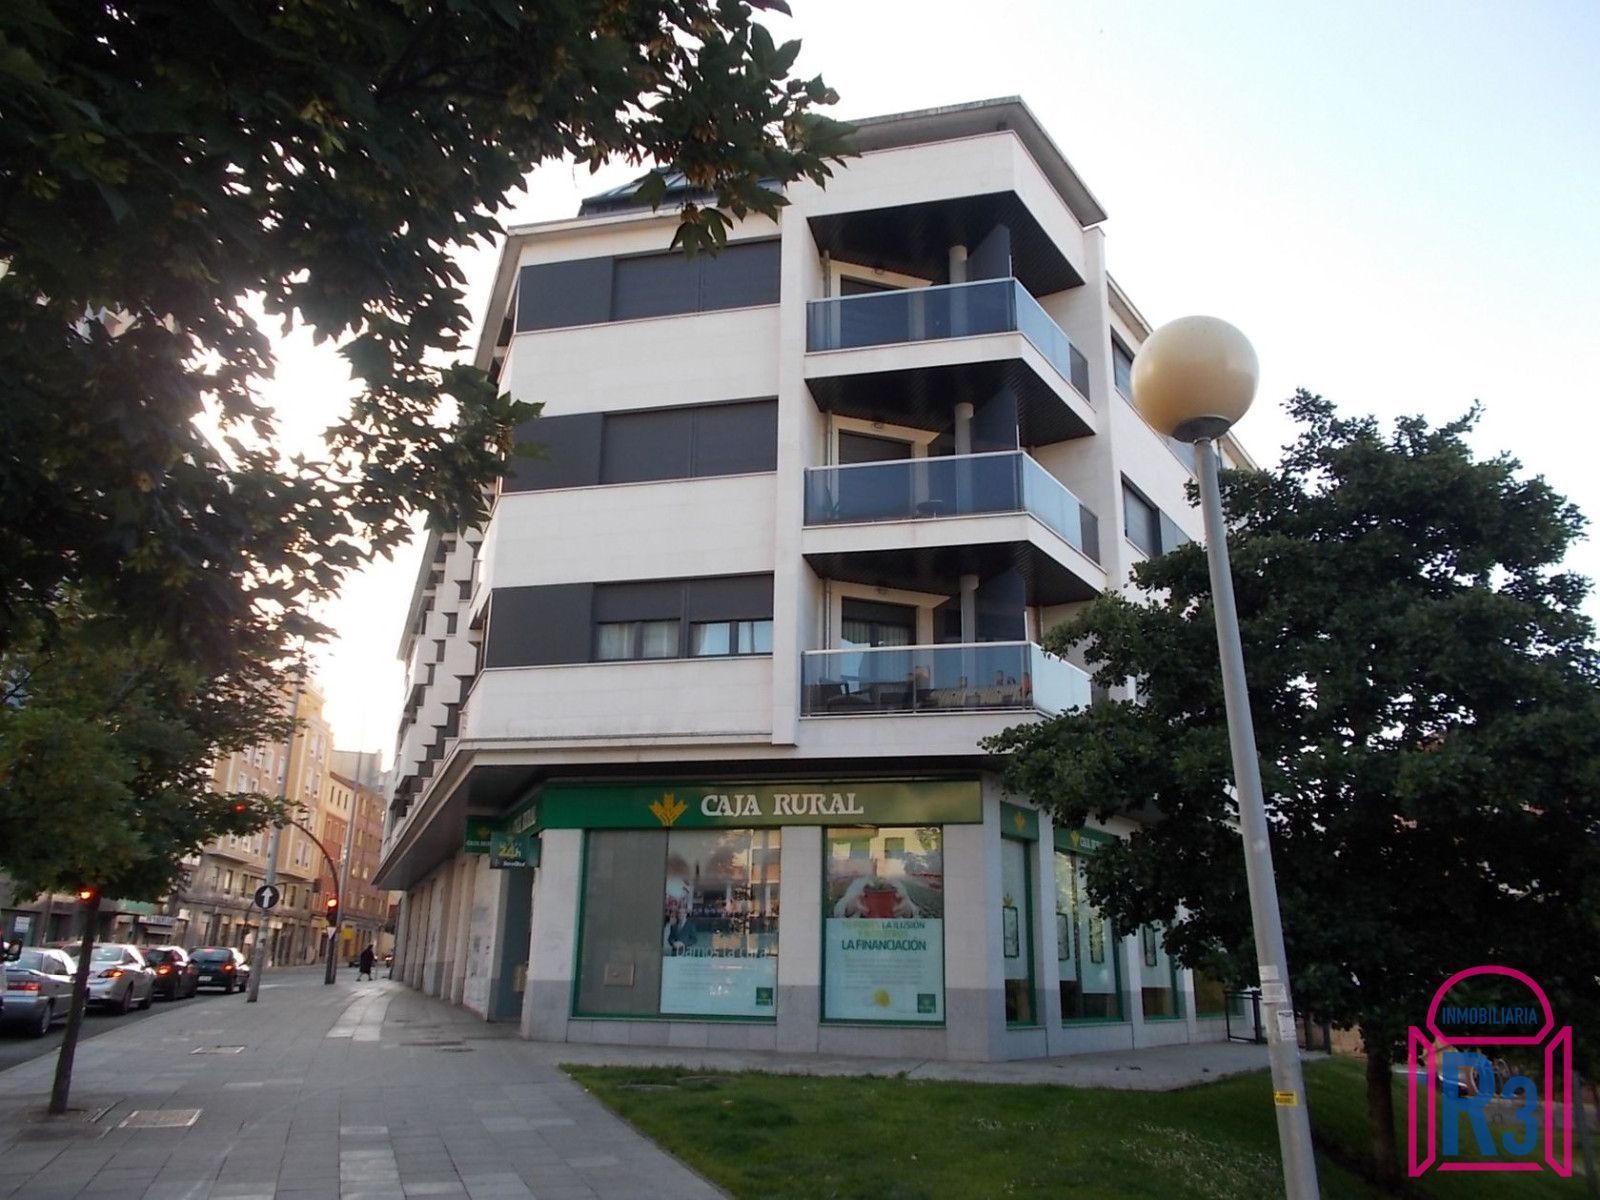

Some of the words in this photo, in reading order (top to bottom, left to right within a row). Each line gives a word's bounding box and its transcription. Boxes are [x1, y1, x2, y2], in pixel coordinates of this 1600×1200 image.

[700, 794, 762, 817] CAJA
[773, 792, 864, 816] RURAL
[841, 939, 855, 950] LA
